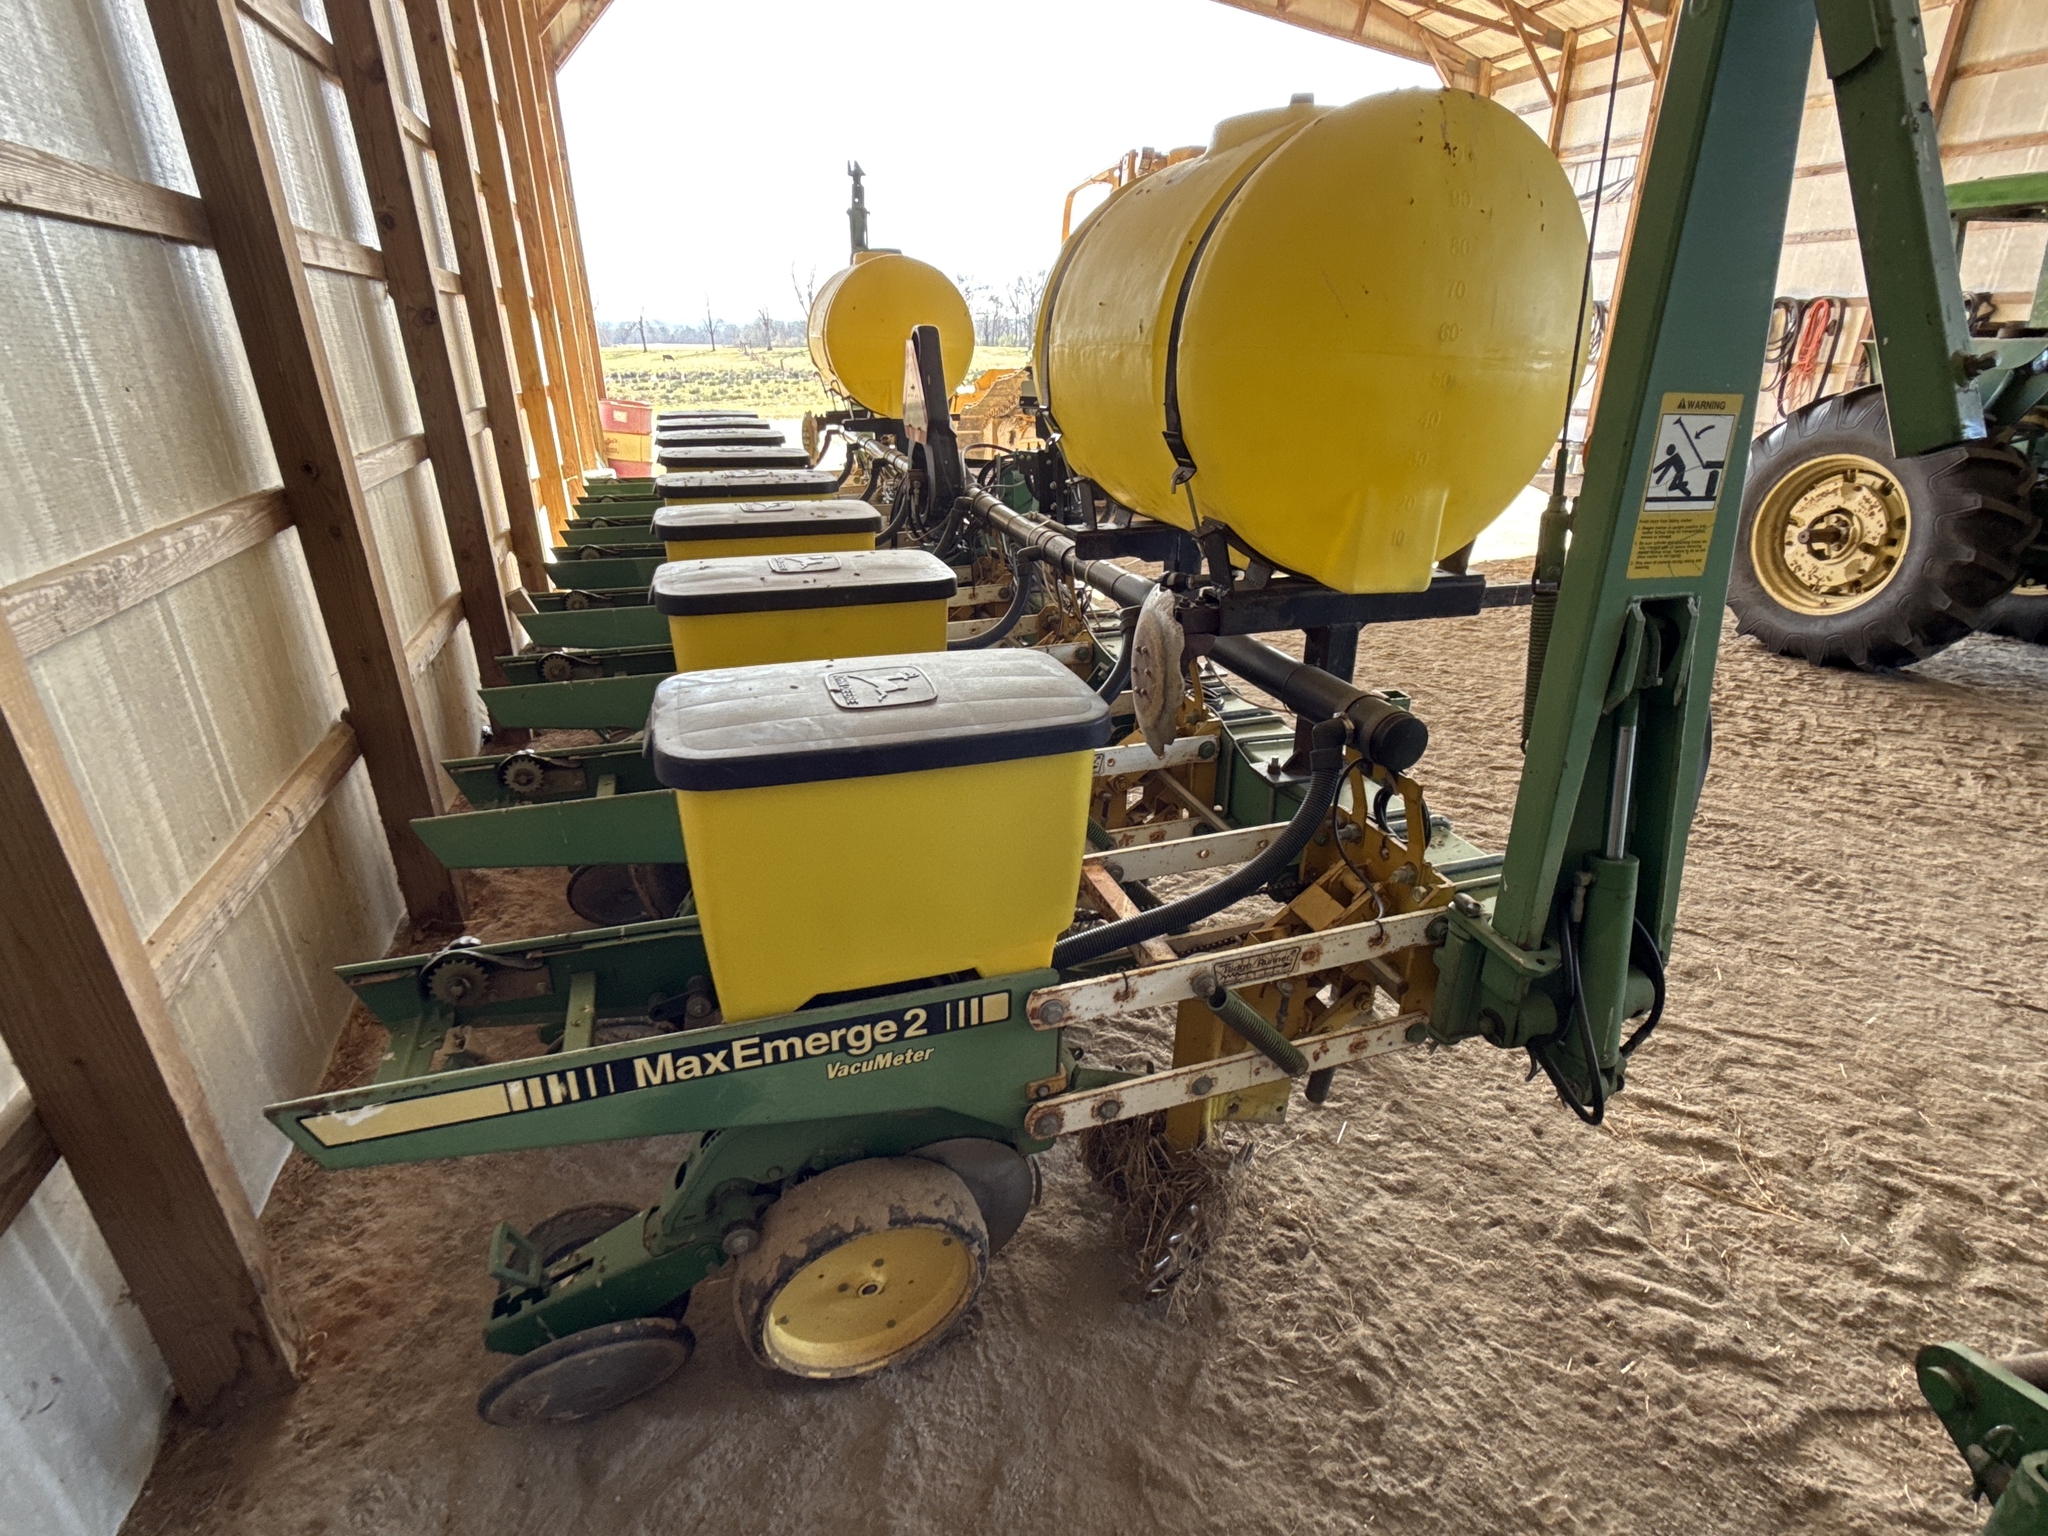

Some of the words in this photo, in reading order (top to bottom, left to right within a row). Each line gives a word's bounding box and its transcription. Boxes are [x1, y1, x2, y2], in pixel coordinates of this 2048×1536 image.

[1450, 236, 1471, 257] 80
[1447, 280, 1467, 299] 70
[1438, 321, 1460, 342] 60
[1431, 371, 1455, 389] 50
[1687, 400, 1726, 410] WARNING
[1420, 409, 1443, 429] 40
[632, 1017, 898, 1089] MaxEmerge
[903, 1008, 928, 1038] 2
[825, 1046, 935, 1080] VacuMeter
